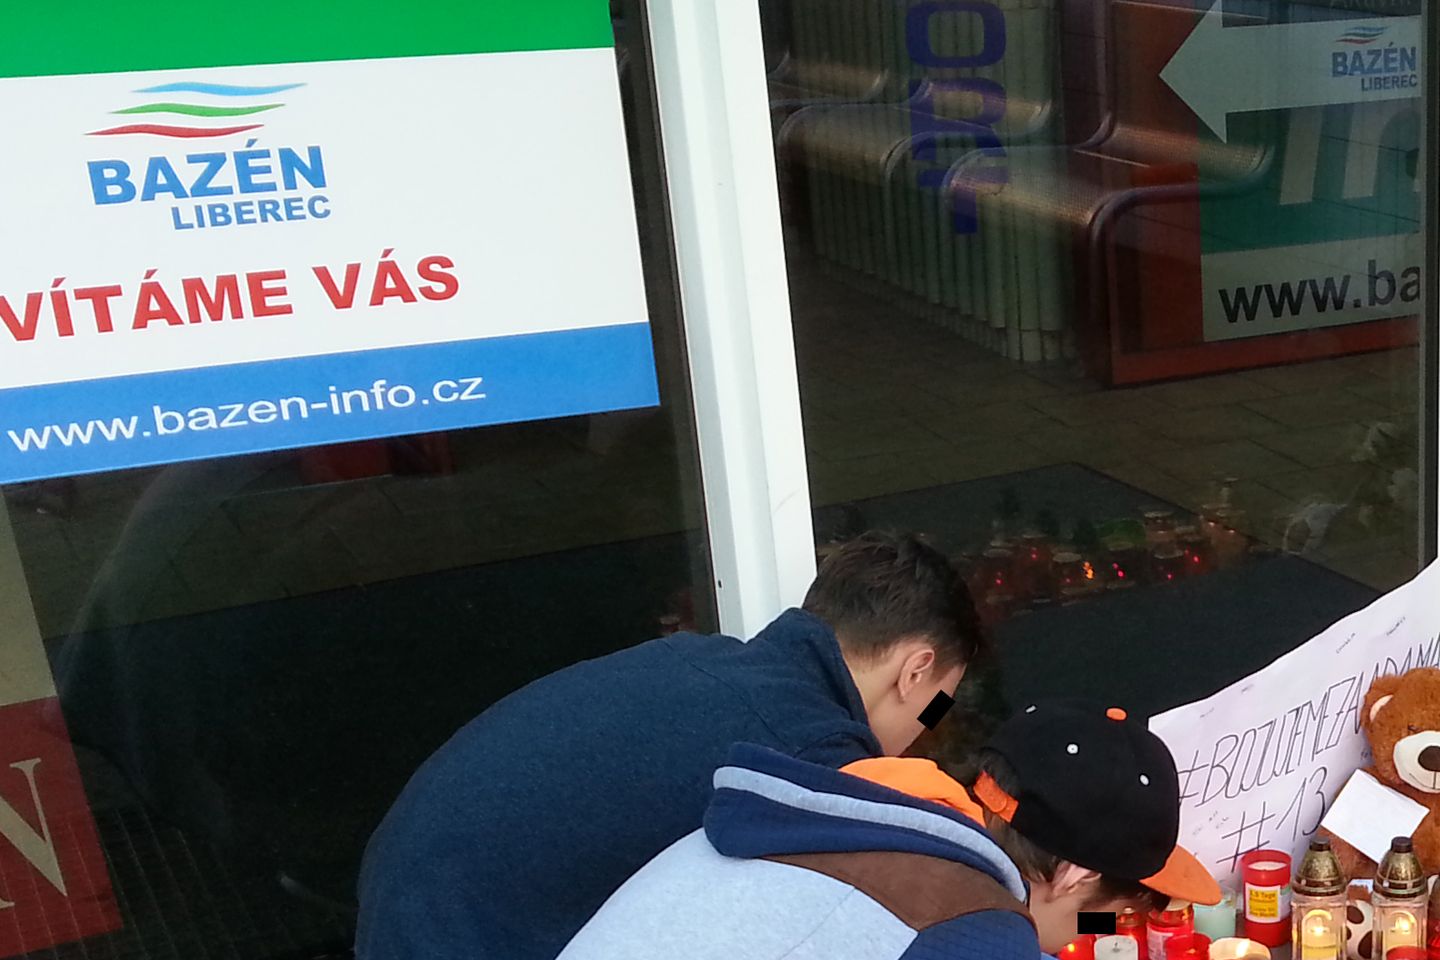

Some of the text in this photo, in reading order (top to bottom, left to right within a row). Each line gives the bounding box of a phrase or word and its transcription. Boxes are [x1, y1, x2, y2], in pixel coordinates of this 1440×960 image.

[1331, 41, 1417, 78] BAZÉN
[1360, 72, 1418, 92] LIBEREC
[86, 138, 328, 206] BAZÉN
[170, 194, 332, 231] LIBEREC
[0, 247, 461, 342] VÍTÁME VÁS
[7, 373, 487, 454] www.bazen-info.cz
